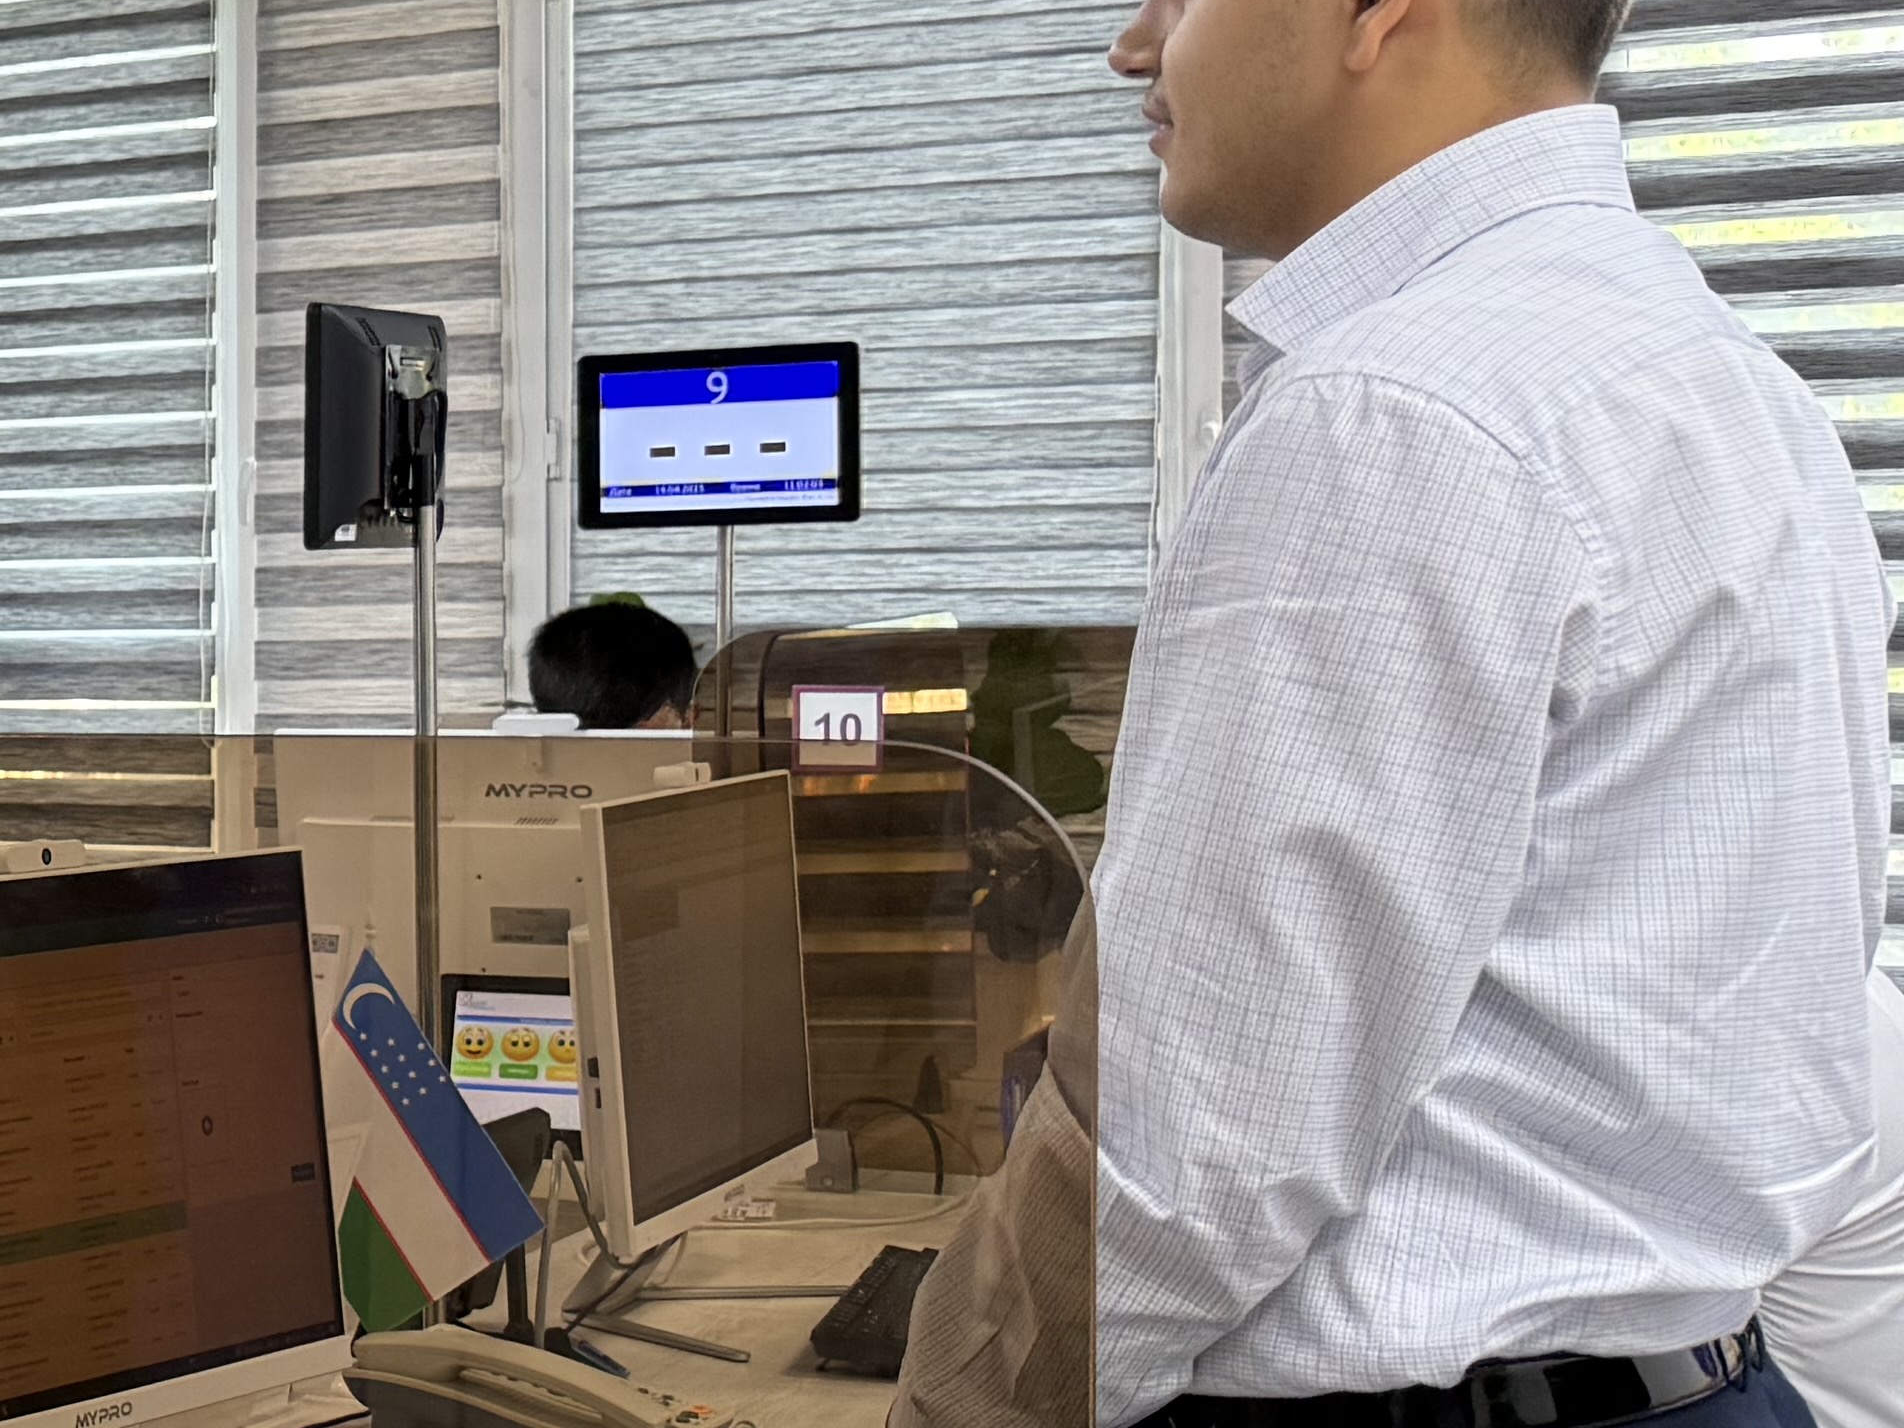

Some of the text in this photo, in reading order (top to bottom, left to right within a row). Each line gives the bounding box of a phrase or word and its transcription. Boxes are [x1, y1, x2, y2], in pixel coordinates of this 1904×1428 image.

[705, 371, 728, 404] 9
[814, 712, 862, 747] 10
[484, 783, 593, 799] MYPRO
